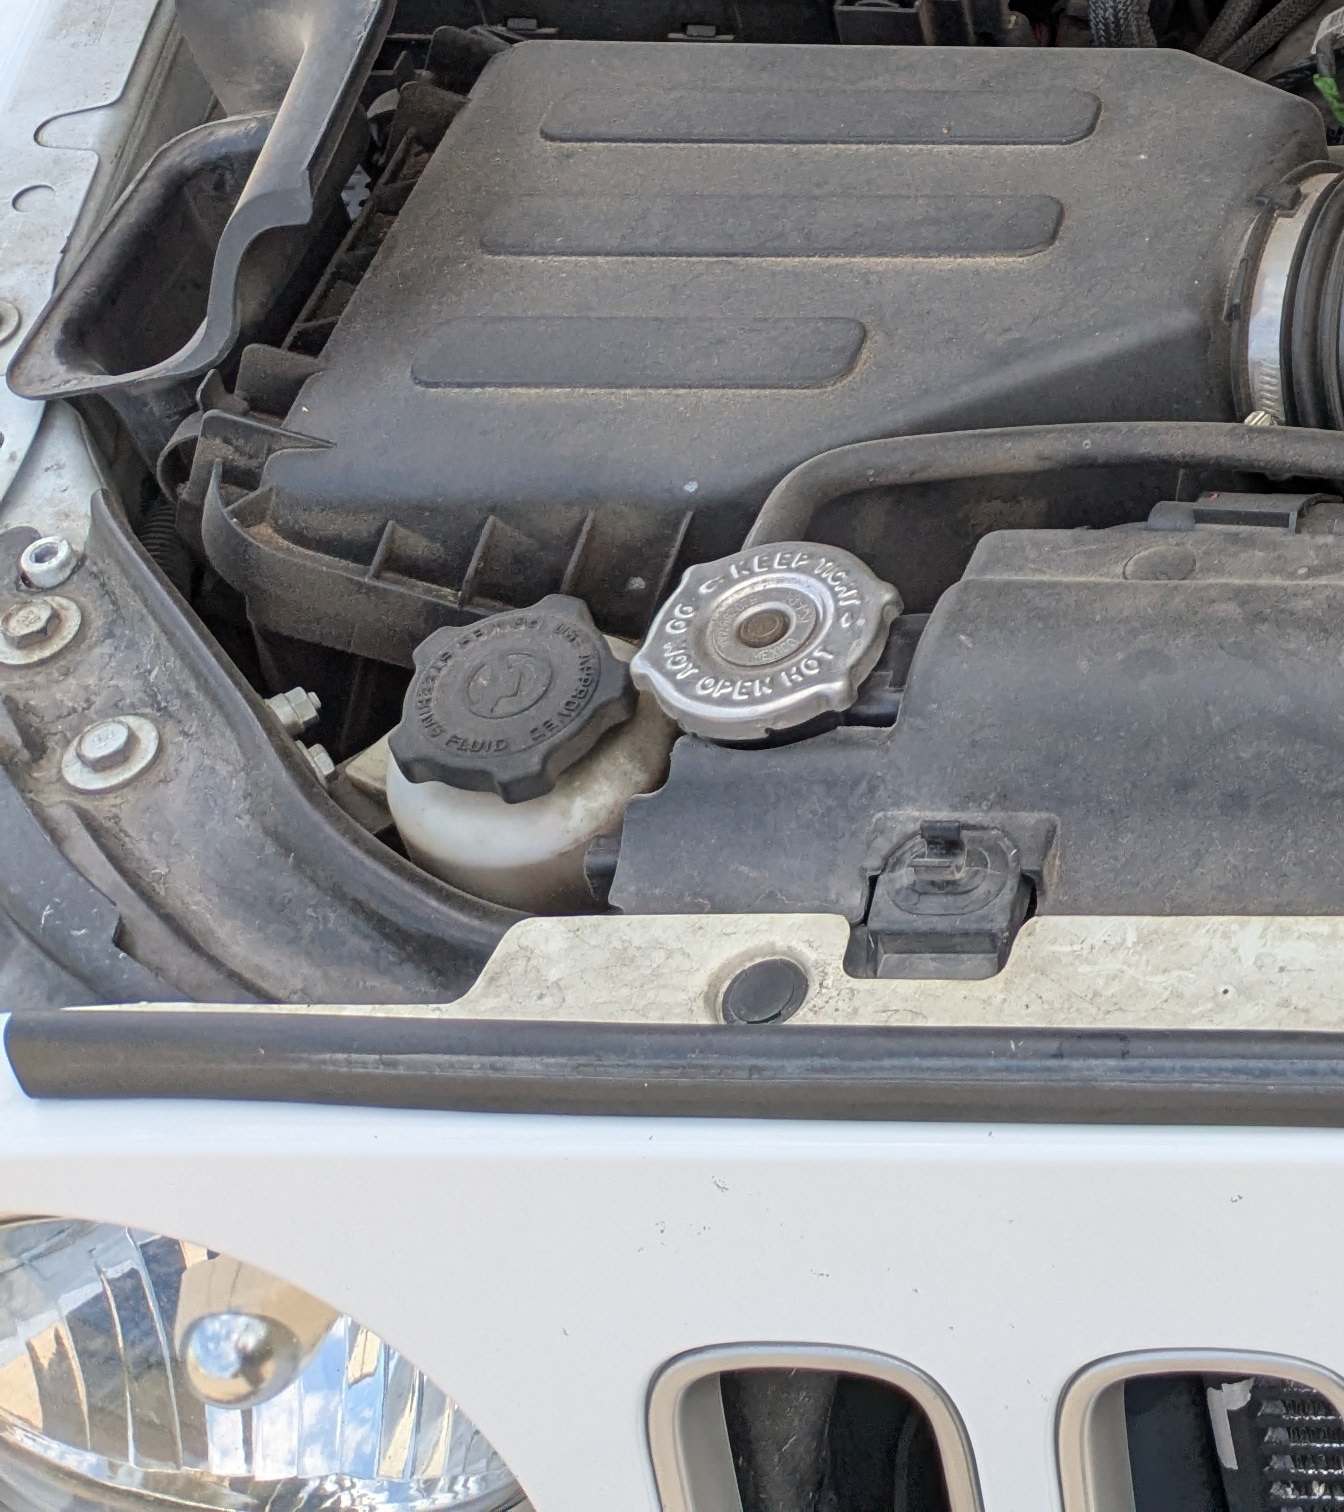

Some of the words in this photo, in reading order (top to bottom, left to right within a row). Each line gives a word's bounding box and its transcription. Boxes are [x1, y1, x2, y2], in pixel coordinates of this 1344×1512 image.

[730, 551, 811, 581] KEEP
[662, 640, 699, 681] NOT
[695, 674, 774, 702] OPEN
[780, 648, 836, 688] HOT
[445, 734, 509, 755] FLUID
